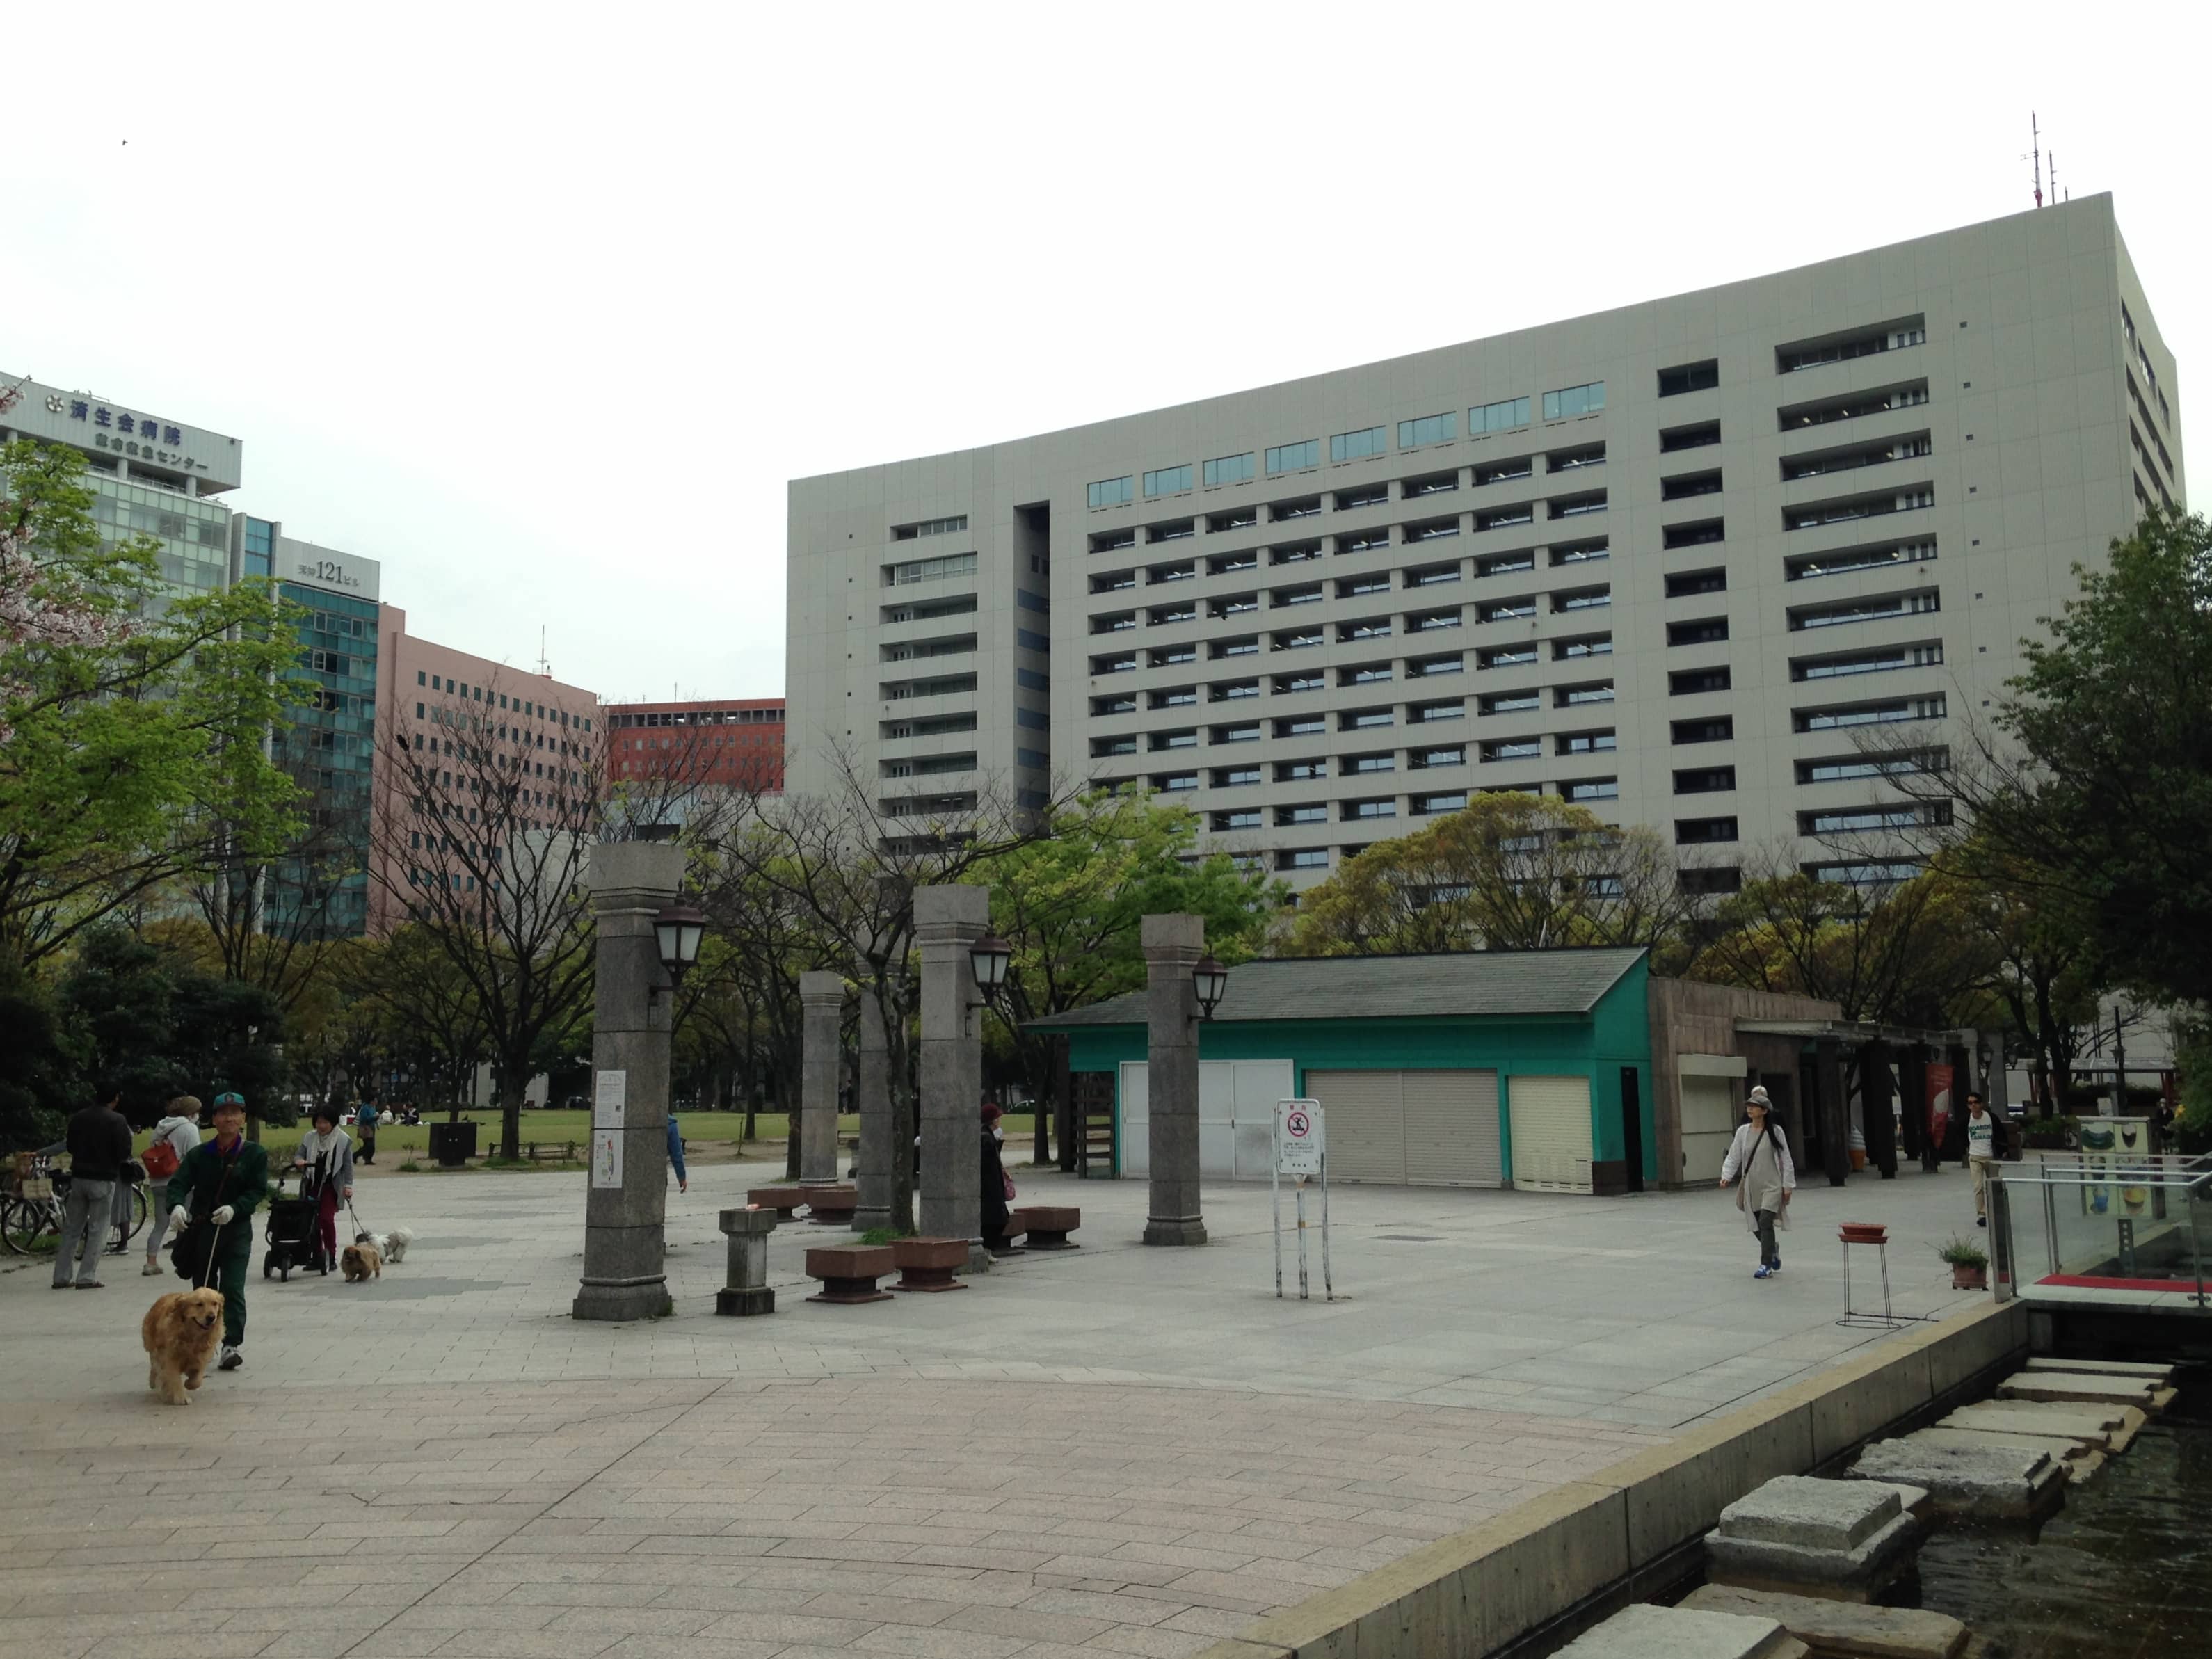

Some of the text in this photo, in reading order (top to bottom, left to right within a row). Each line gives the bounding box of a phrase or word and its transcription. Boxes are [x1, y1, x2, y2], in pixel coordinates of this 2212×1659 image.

[70, 399, 180, 445] 済生会病院
